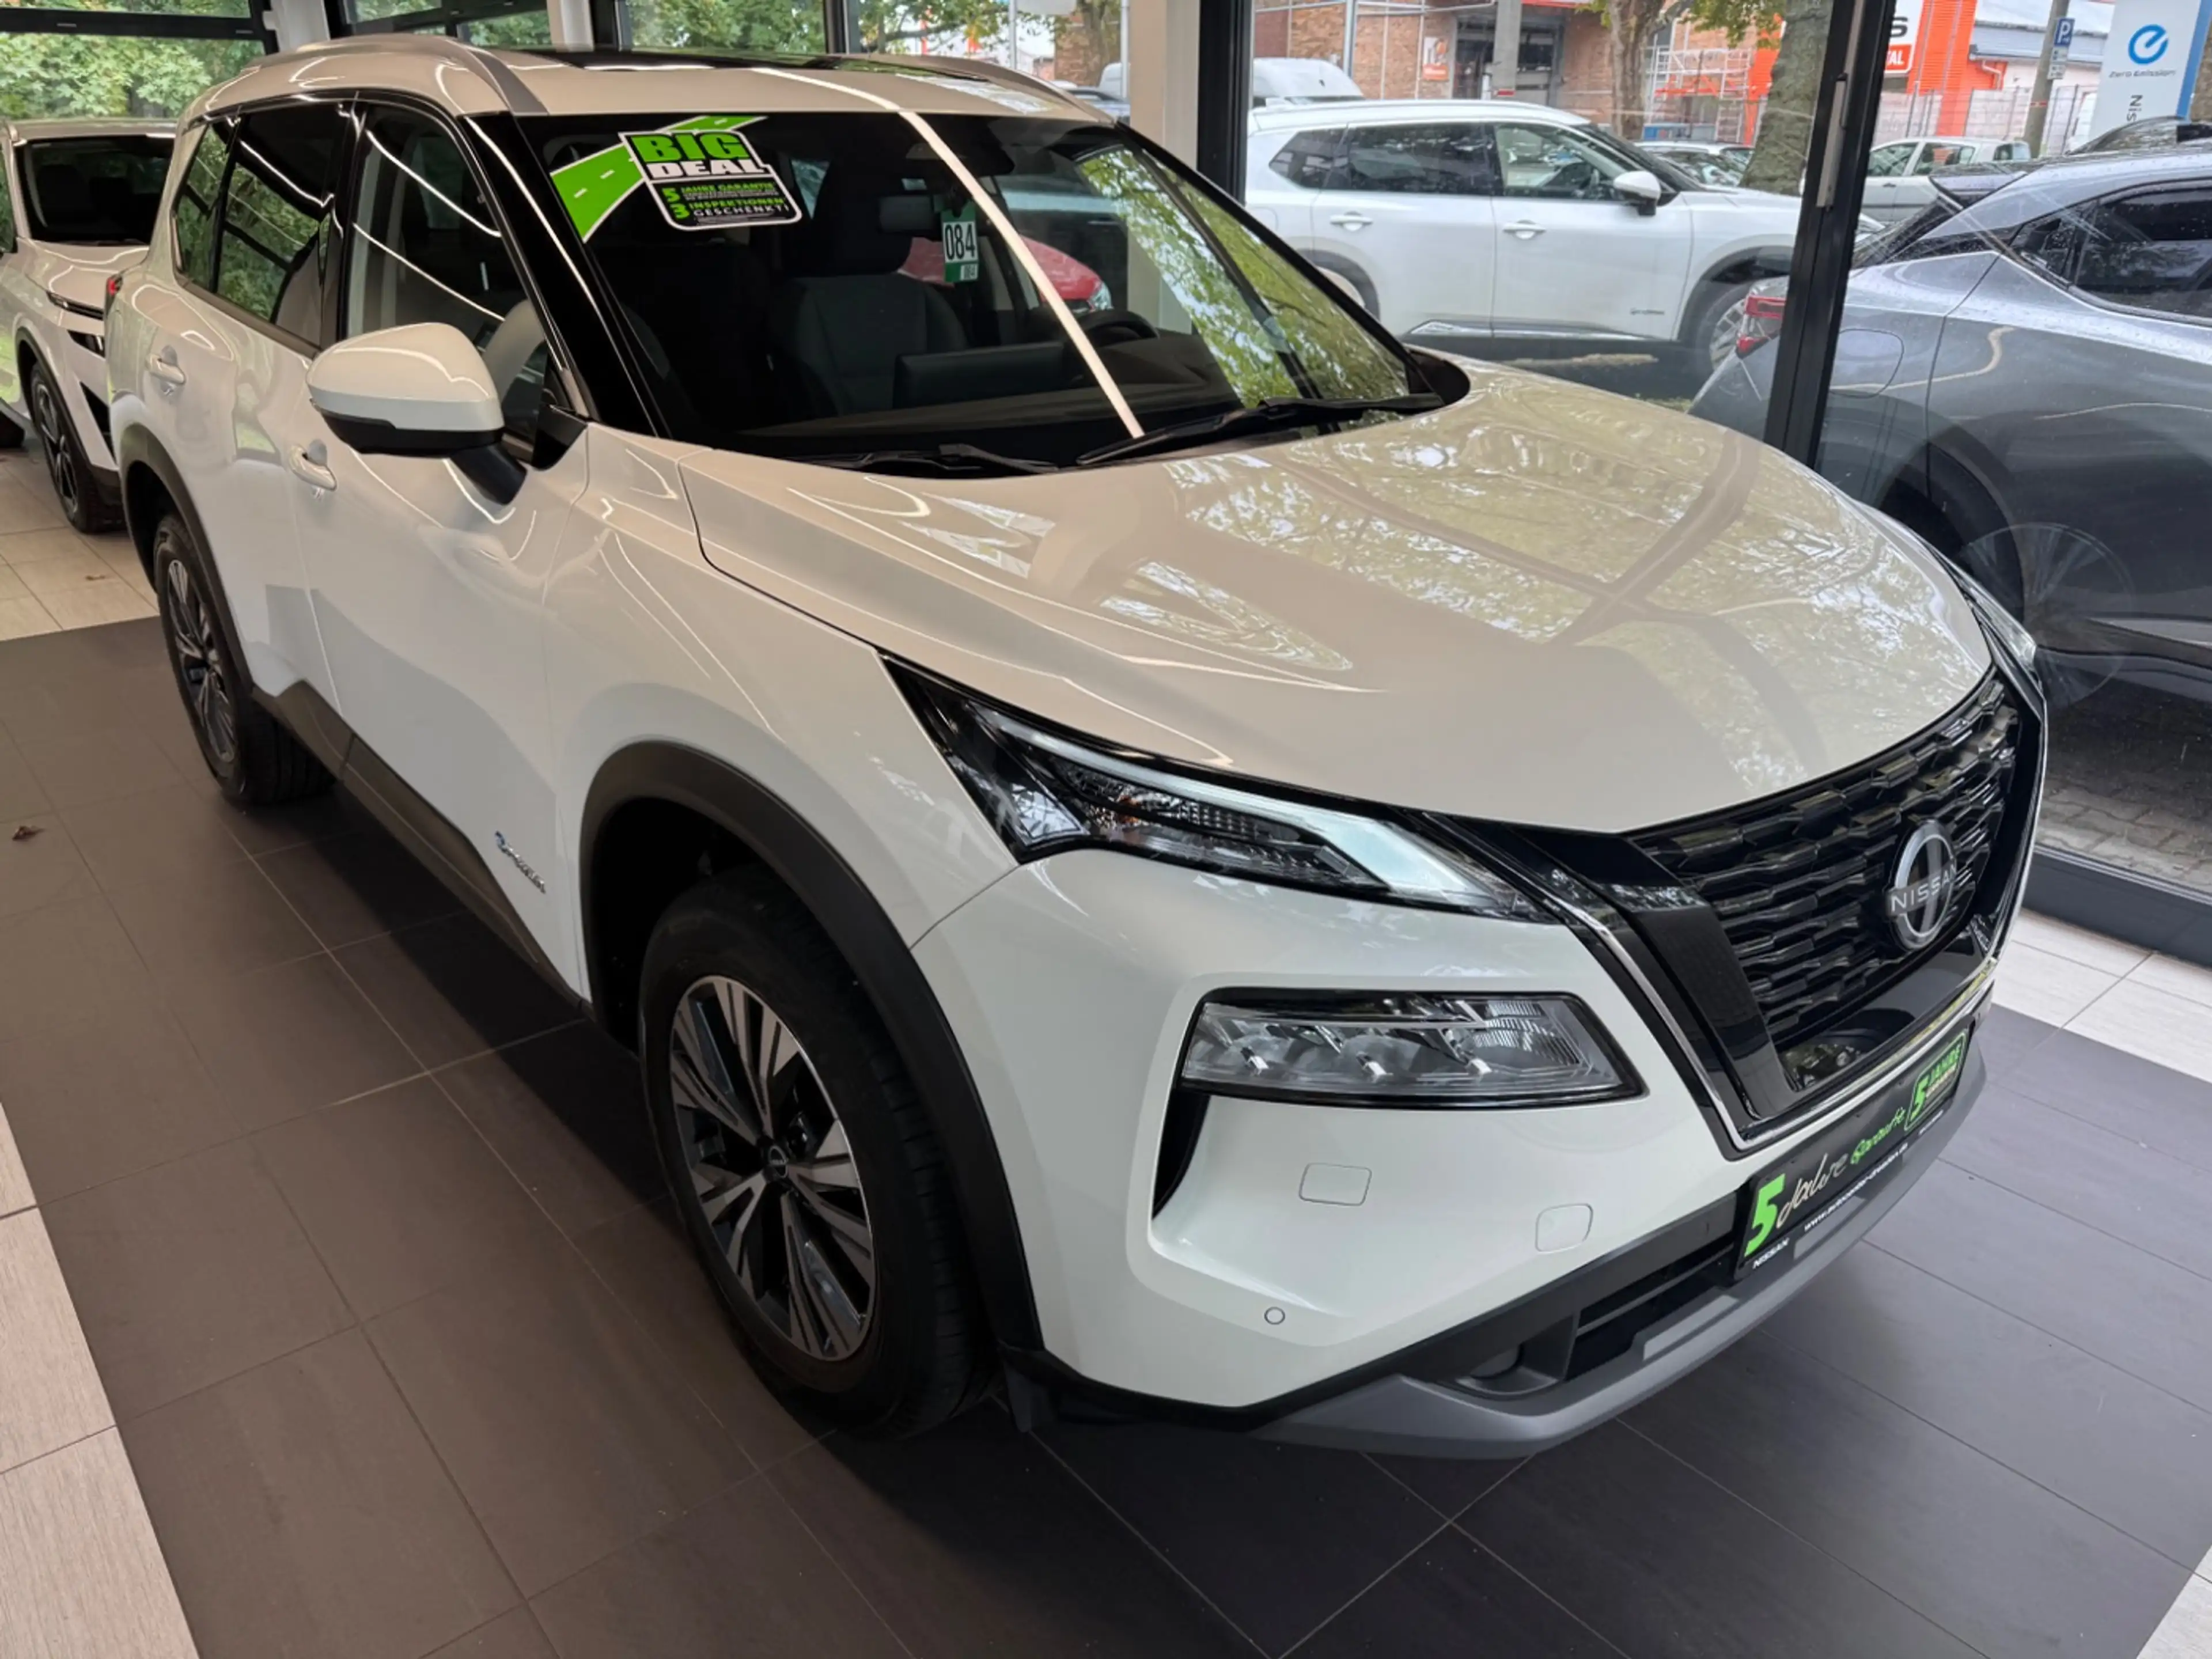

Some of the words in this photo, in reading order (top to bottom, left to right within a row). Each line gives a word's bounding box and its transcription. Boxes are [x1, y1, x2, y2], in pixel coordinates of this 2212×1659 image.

[2058, 21, 2071, 43] P
[631, 133, 749, 162] BIG
[646, 158, 764, 178] DEAL
[662, 187, 681, 203] 5
[670, 204, 690, 219] 3
[945, 224, 975, 259] 084
[1891, 863, 1956, 912] NISSAN
[1910, 1075, 1930, 1121] 5
[1744, 1173, 1785, 1257] 5
